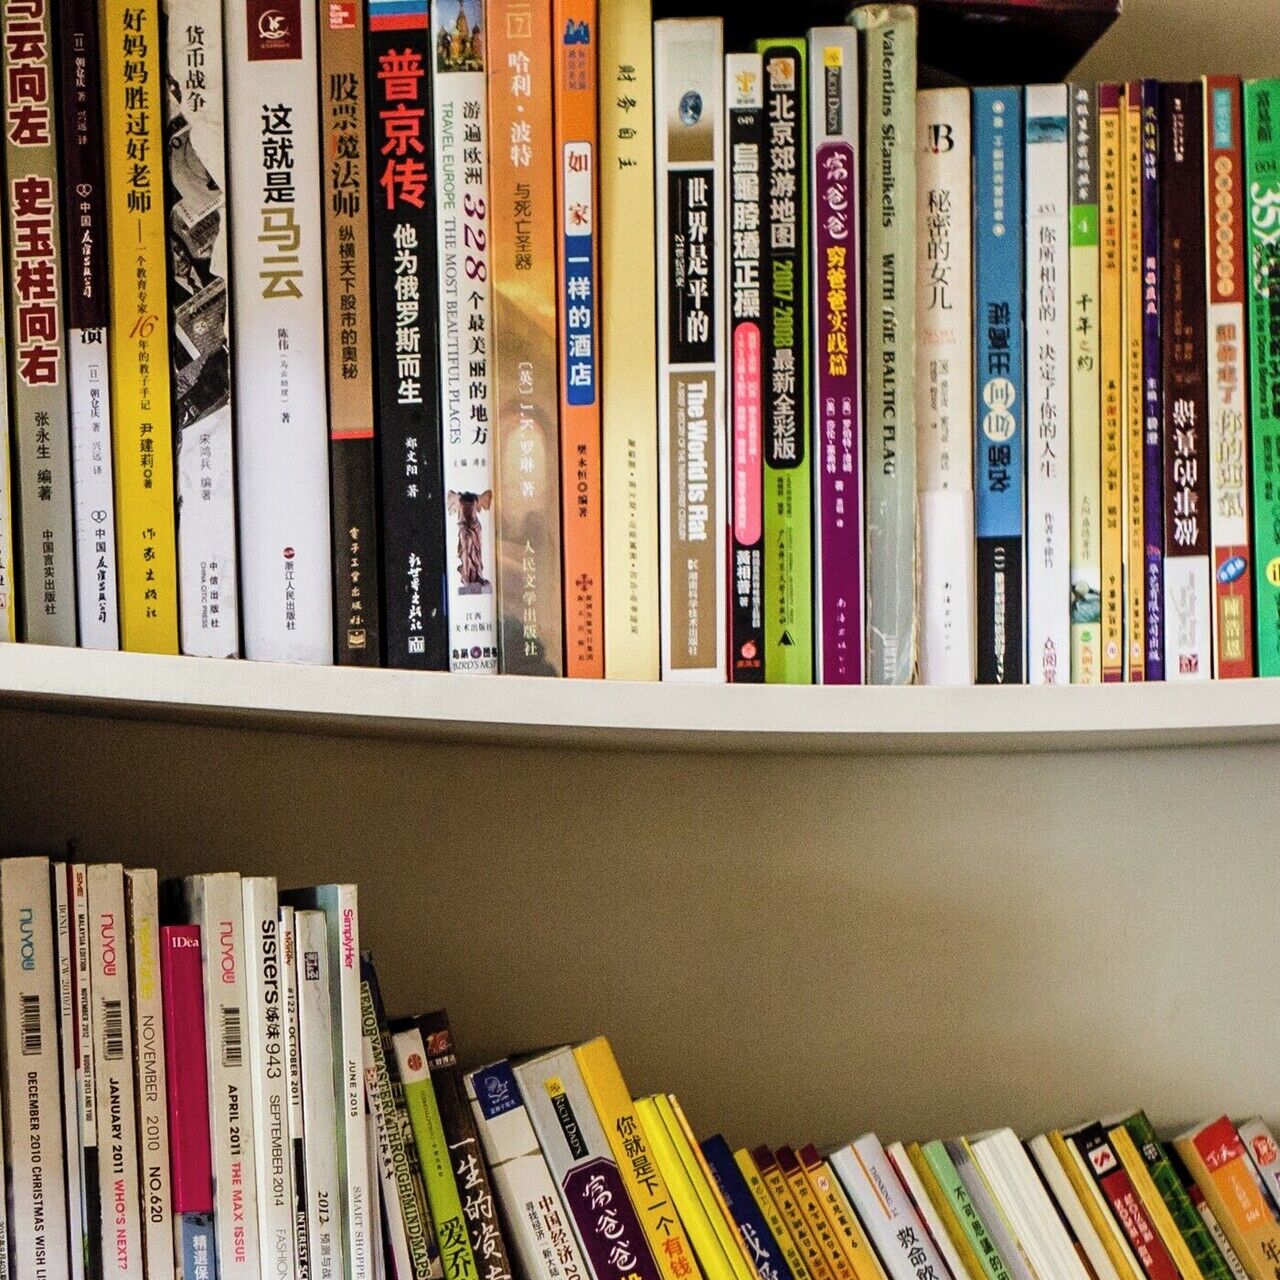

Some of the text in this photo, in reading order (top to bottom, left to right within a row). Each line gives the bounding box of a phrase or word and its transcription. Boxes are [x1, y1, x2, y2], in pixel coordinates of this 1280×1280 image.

[185, 25, 206, 112] 货币战争
[123, 8, 151, 214] 好妈妈胜过好老师
[377, 47, 428, 210] 普京传
[258, 104, 304, 299] 这就是马云
[769, 95, 796, 249] 北京郊游地图
[514, 183, 533, 271] 与死亡圣器
[688, 177, 709, 343] 世界是平的
[11, 174, 62, 386] 史玉柱向右
[442, 102, 461, 444] TRAVEL EUROPE THE MOST BEAUTIFUL PLACES
[826, 245, 848, 376] 穷爸爸实践篇
[882, 253, 896, 300] WITH
[393, 223, 423, 404] 他为俄罗斯而生
[687, 380, 708, 417] The
[882, 350, 896, 420] BALTIC
[687, 420, 708, 481] World
[883, 424, 896, 476] FLAG
[142, 1015, 157, 1102] NOVEMBER
[289, 1026, 299, 1106] OCTOBER 2011
[27, 1071, 40, 1131] DECEMBER
[146, 1115, 159, 1151] 2010
[266, 1043, 284, 1206] 943 SEPTEMBER 2014
[31, 1134, 42, 1163] 2010
[110, 1078, 128, 1270] JANUARY 2011 WHO'S NEXT?
[227, 1084, 245, 1263] APRIL 2011 THE MAX ISSUE
[32, 1166, 45, 1232] CHRISTMAS
[149, 1166, 163, 1224] NO.620
[353, 1186, 362, 1225] SMART
[539, 1195, 574, 1262] 中国经济
[35, 1235, 46, 1263] WISH
[276, 1229, 288, 1278] FASHION
[297, 1211, 308, 1264] INTEREST
[410, 1240, 431, 1280] MAPS
